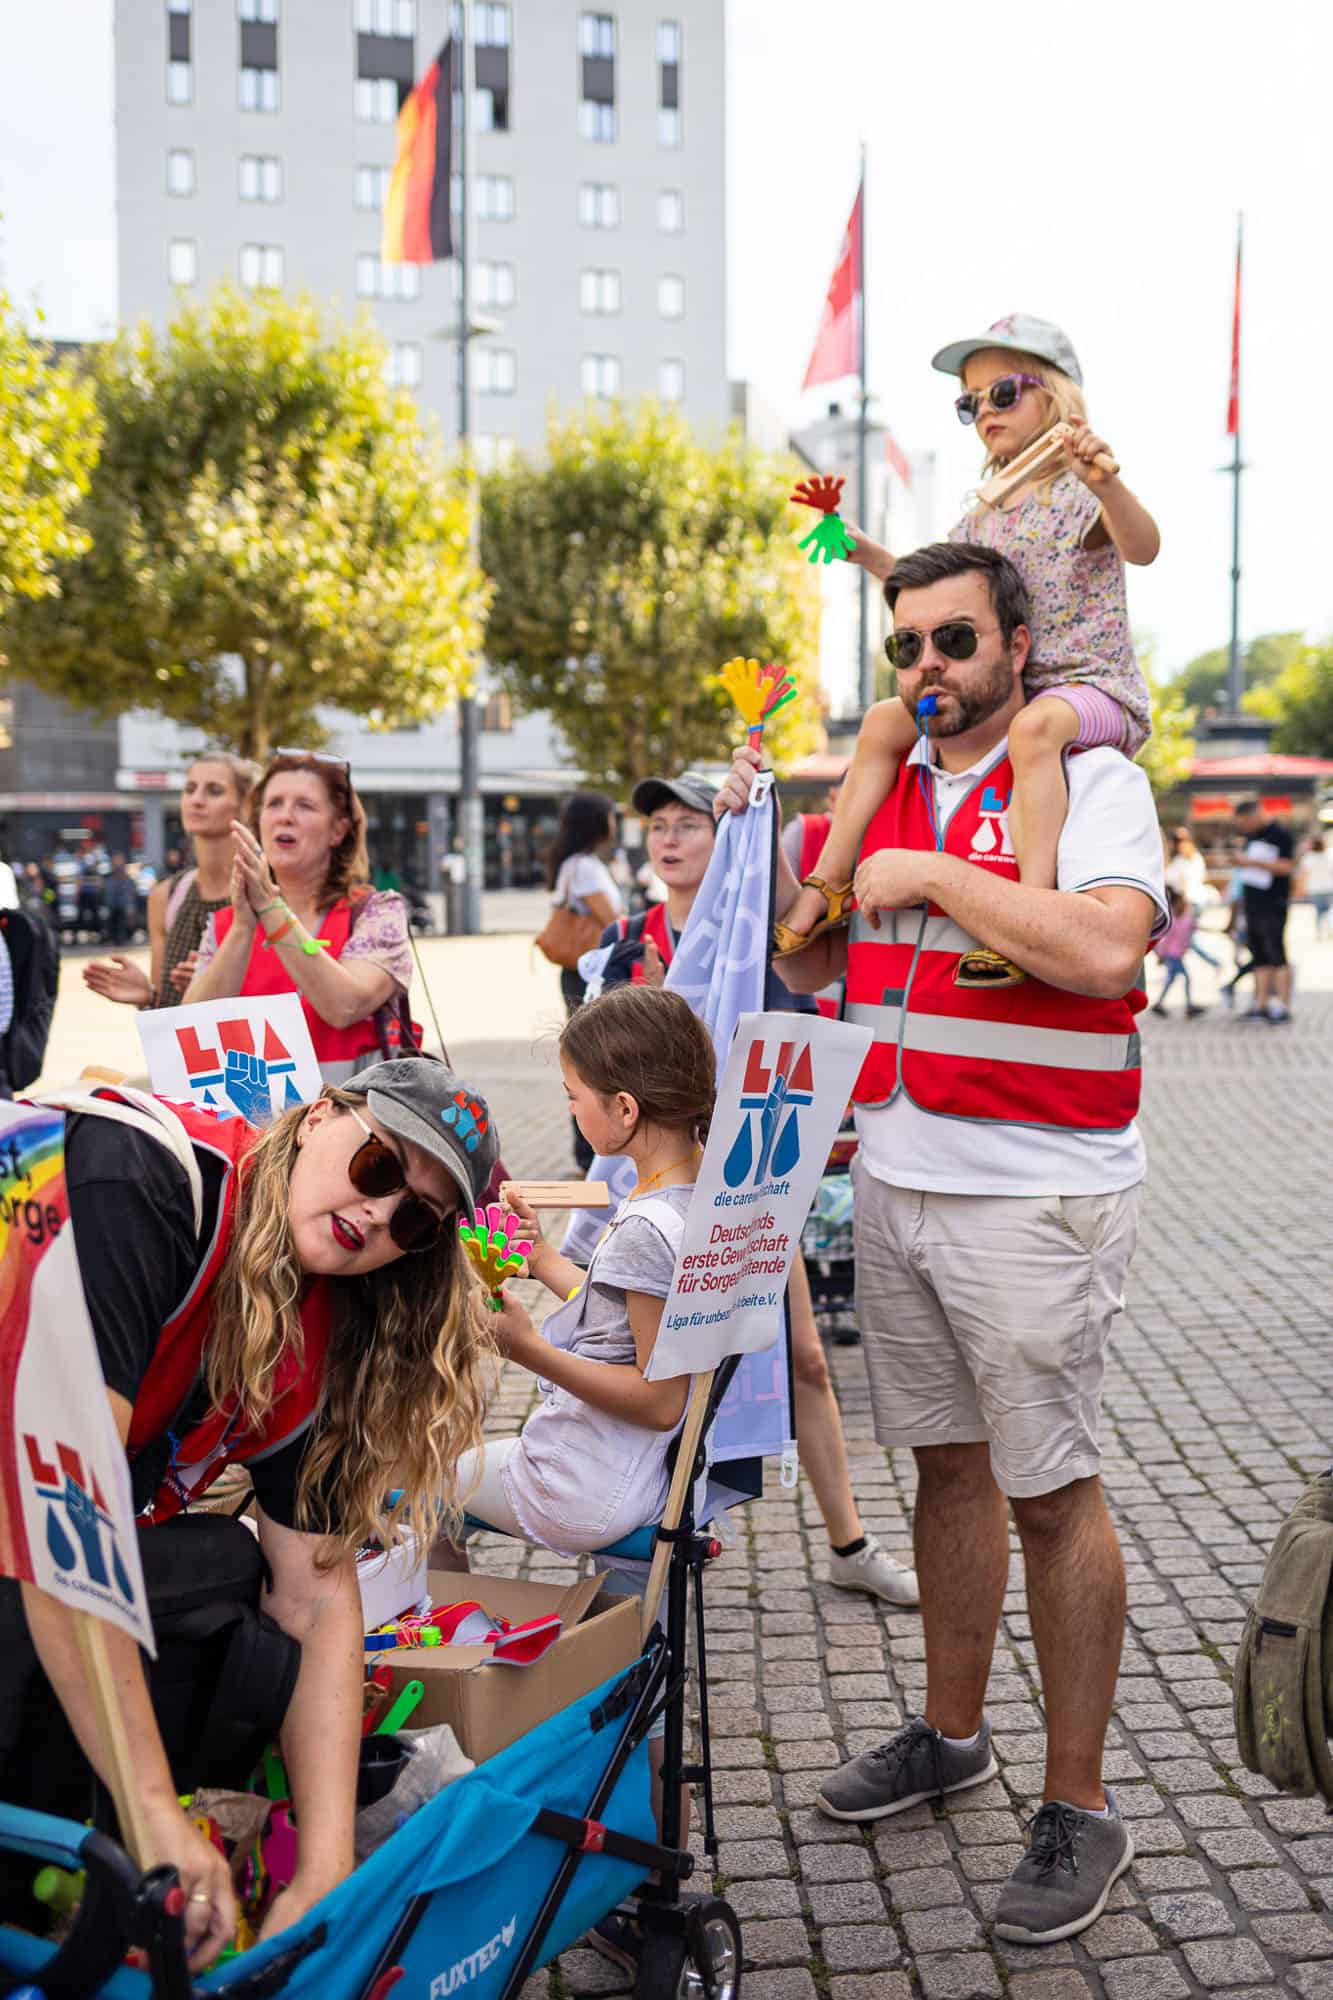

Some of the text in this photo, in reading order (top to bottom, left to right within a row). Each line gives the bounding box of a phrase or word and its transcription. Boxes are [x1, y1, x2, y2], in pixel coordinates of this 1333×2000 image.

[714, 1191, 732, 1207] die
[682, 1250, 719, 1270] erste
[676, 1273, 701, 1295] für
[667, 1314, 689, 1330] Liga
[689, 1312, 705, 1326] für
[759, 1292, 777, 1306] e.V.
[430, 1933, 502, 2000] FUXTEC
